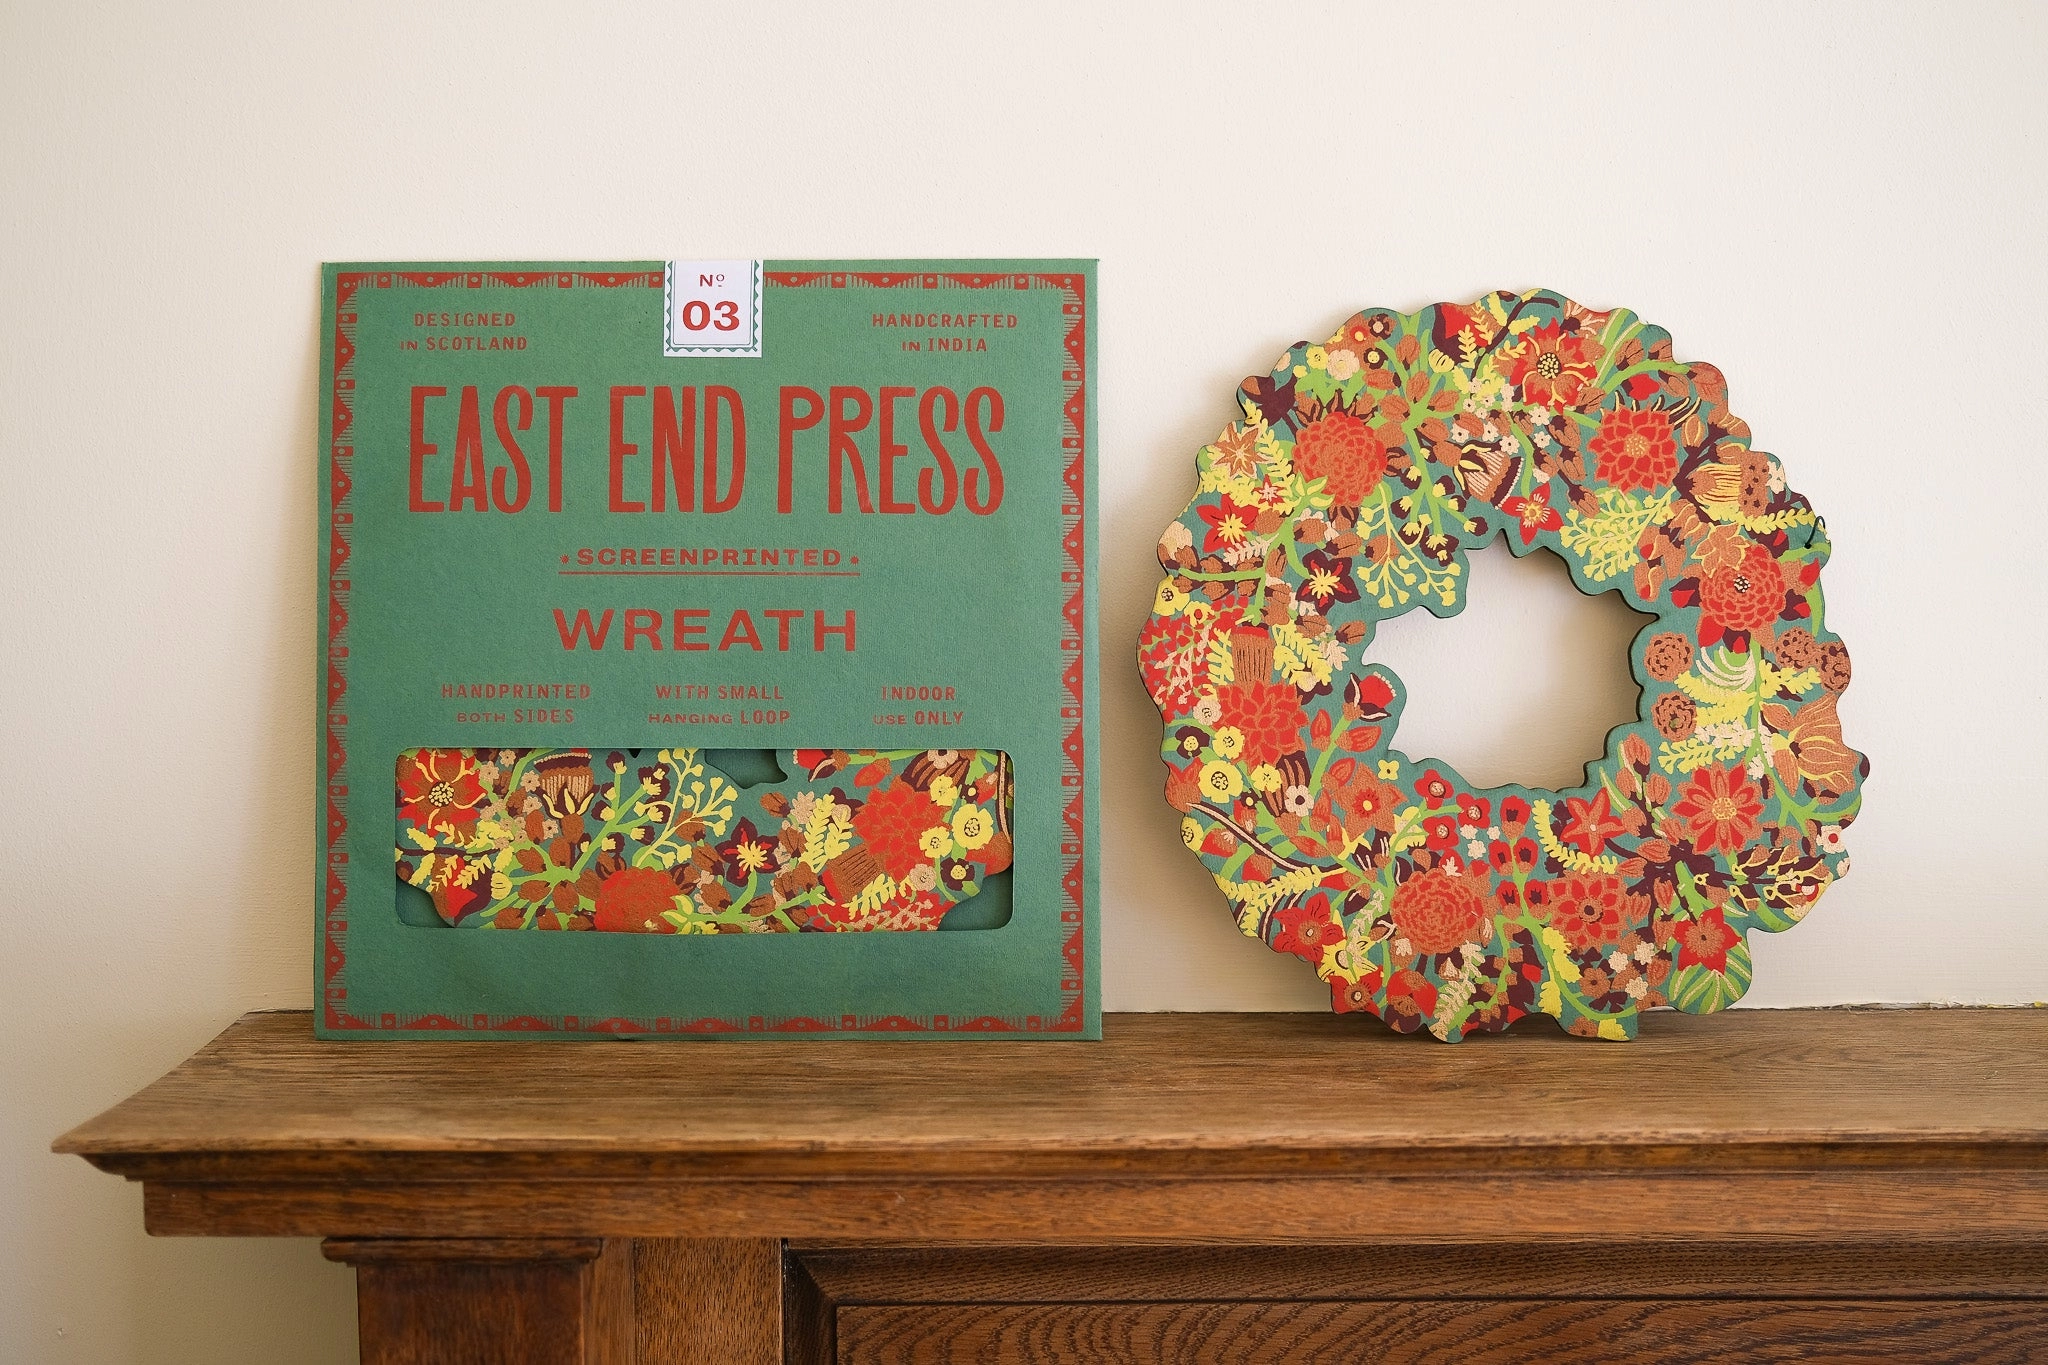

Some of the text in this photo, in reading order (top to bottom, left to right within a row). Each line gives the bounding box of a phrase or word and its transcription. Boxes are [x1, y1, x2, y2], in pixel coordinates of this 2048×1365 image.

[414, 312, 515, 327] DESIGNED
[683, 301, 739, 331] 03
[872, 313, 1017, 328] HANDCRAFTED
[400, 336, 527, 351] IN SCOTLAND
[901, 338, 987, 352] IN INDIA
[409, 385, 1004, 515] EAST END PRESS
[578, 548, 841, 566] SCREENPRINTED
[553, 609, 856, 651] WREATH
[442, 684, 590, 699] HANDPRINTED
[656, 685, 785, 700] WITH SMALL
[882, 686, 955, 701] INDOOR
[457, 709, 574, 723] BOTH SIDES
[648, 710, 790, 724] HANGING LOOP
[873, 710, 963, 725] USE ONLY
